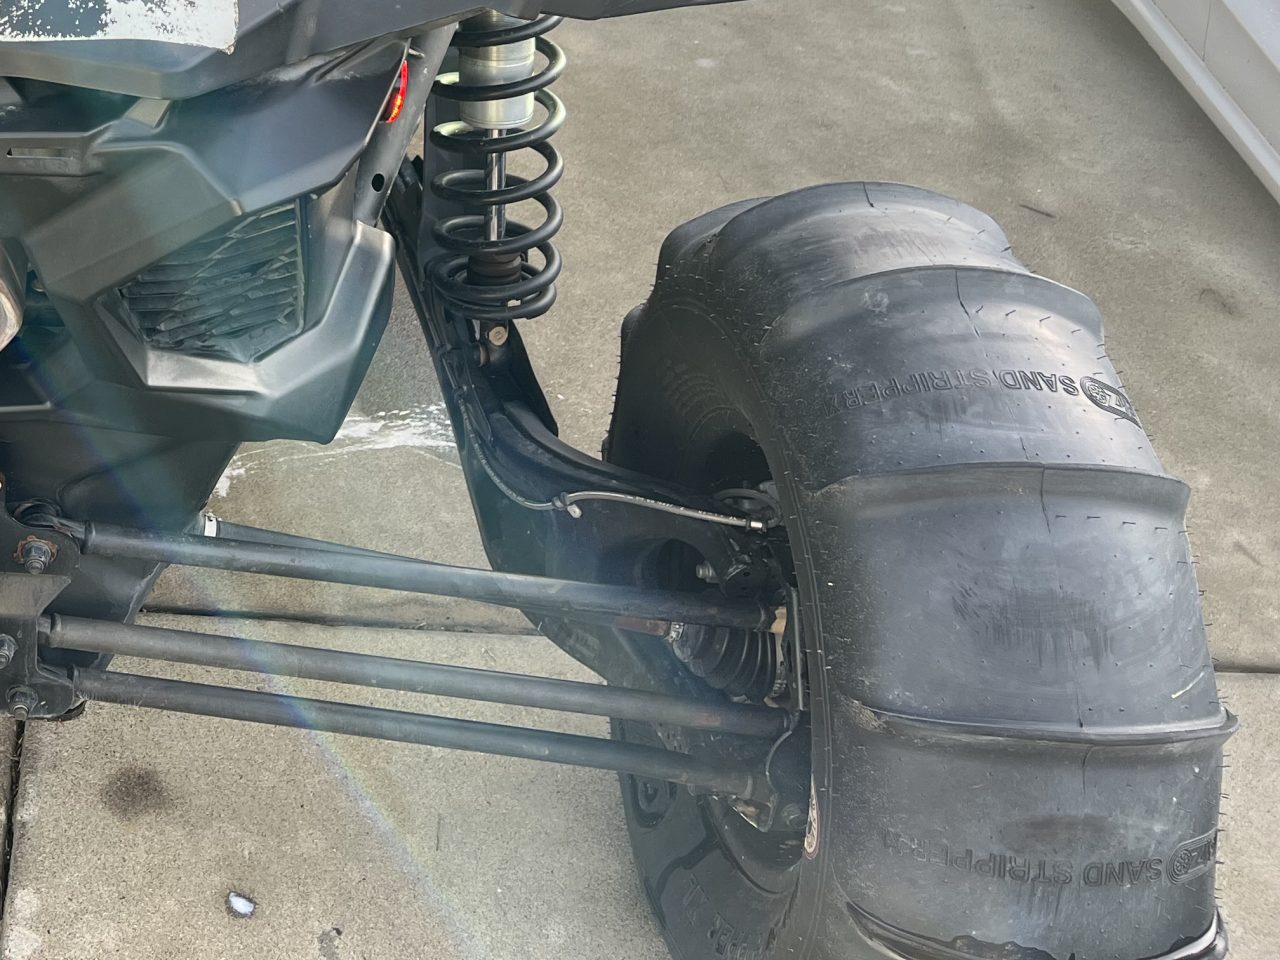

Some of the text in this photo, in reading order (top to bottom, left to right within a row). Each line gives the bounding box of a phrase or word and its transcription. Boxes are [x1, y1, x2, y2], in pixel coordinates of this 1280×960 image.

[842, 368, 991, 409] STRIPPER
[1001, 369, 1080, 396] SAND
[1083, 859, 1163, 886] SAND
